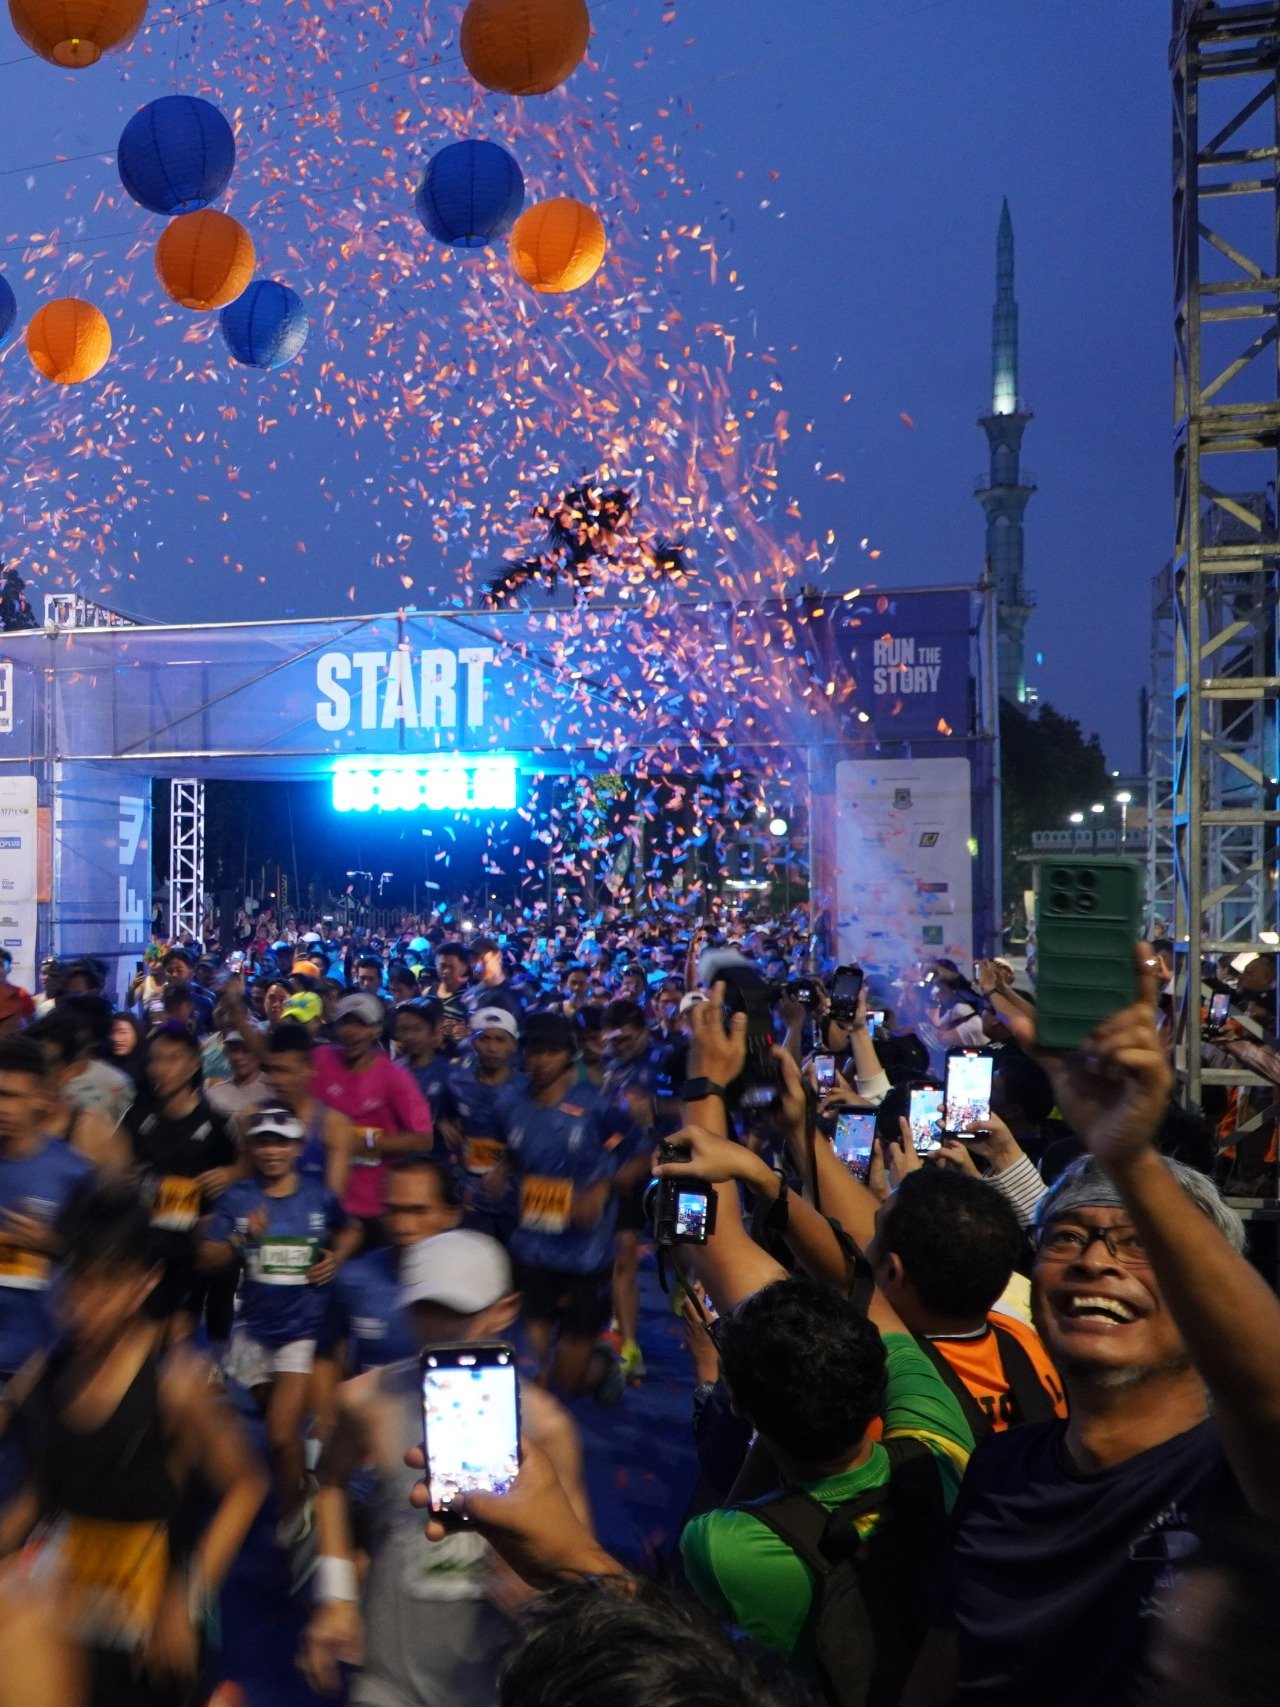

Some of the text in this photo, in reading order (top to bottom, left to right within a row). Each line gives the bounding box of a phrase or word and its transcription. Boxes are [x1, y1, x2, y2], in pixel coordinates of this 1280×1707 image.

[873, 638, 941, 666] RUN THE
[316, 647, 494, 731] START
[873, 666, 941, 694] STORY
[0, 717, 10, 727] 10K
